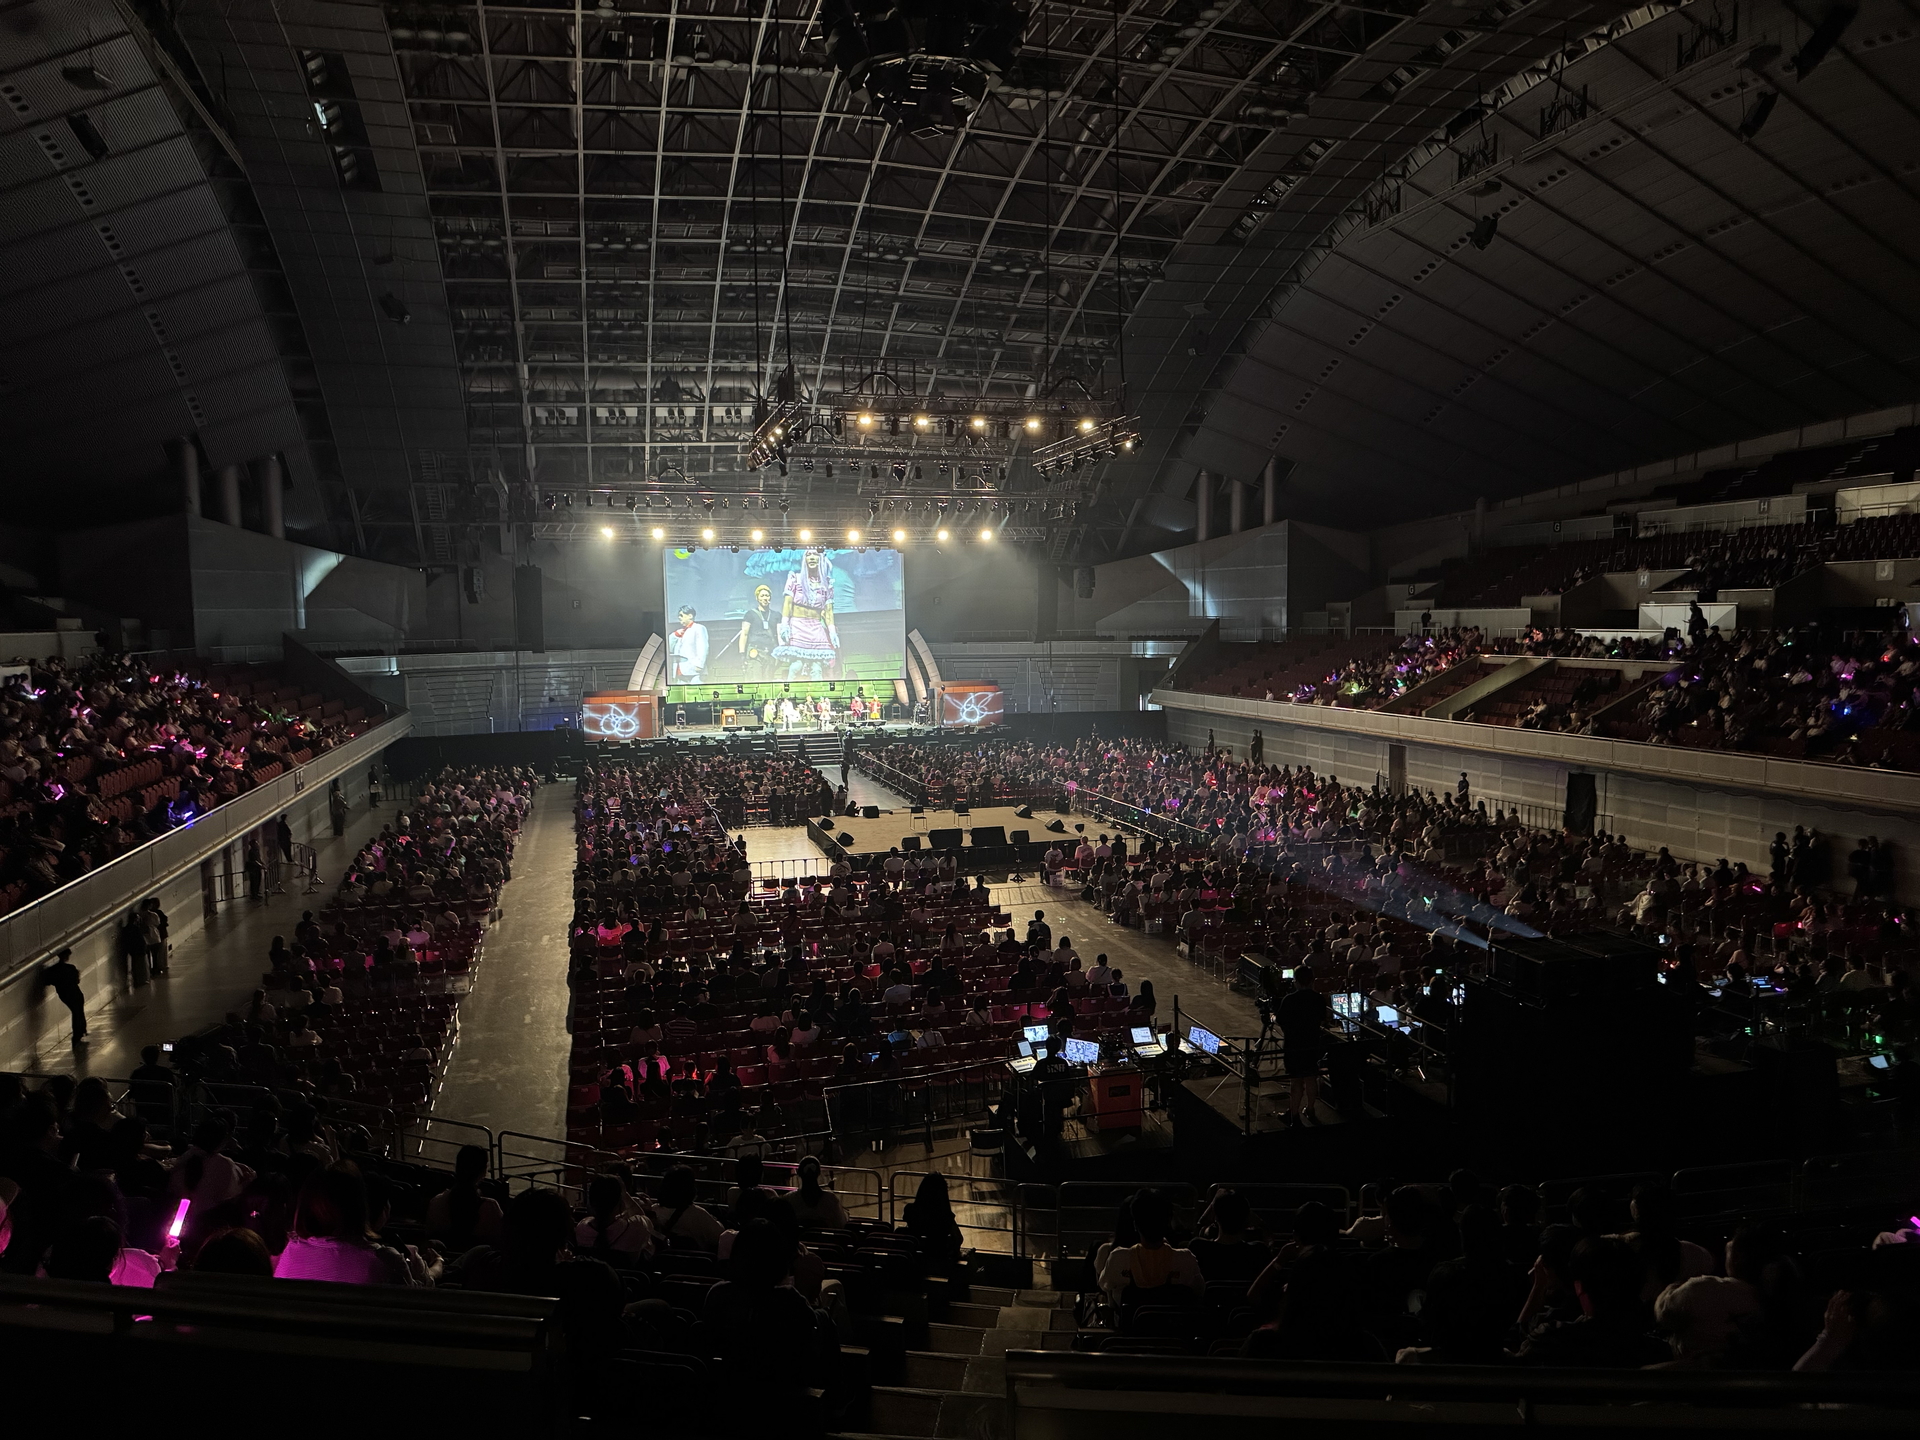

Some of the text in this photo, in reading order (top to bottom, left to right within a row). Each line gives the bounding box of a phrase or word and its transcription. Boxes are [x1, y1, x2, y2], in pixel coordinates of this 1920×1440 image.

[1760, 502, 1768, 512] H
[1554, 523, 1560, 532] G
[1881, 564, 1888, 577] J
[1640, 575, 1648, 585] H
[573, 600, 579, 608] F
[1046, 1063, 1065, 1074] STAFF
